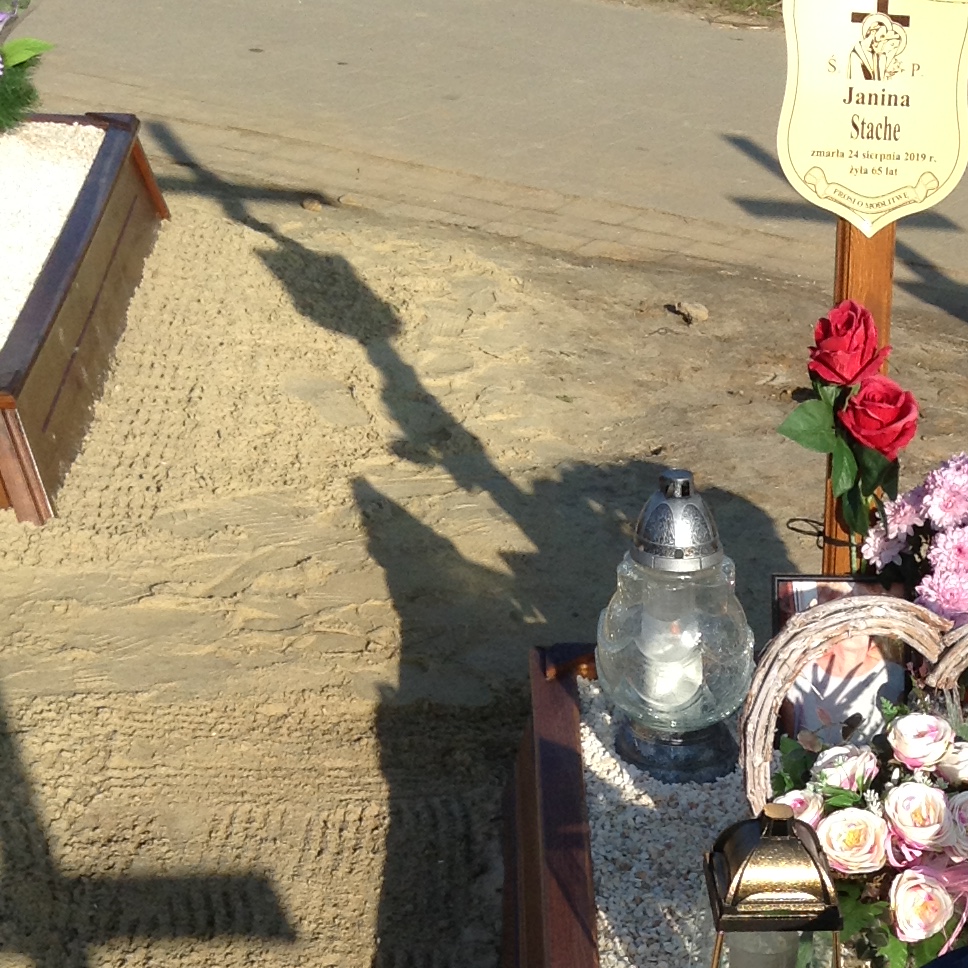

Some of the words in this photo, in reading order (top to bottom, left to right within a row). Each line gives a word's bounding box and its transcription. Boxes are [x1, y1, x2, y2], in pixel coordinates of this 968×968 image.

[843, 87, 910, 107] Janina
[850, 114, 901, 141] Stache
[848, 149, 859, 159] 24
[862, 150, 901, 162] sierpnia
[904, 152, 927, 162] 2019
[871, 166, 883, 175] 65
[885, 167, 898, 176] lat
